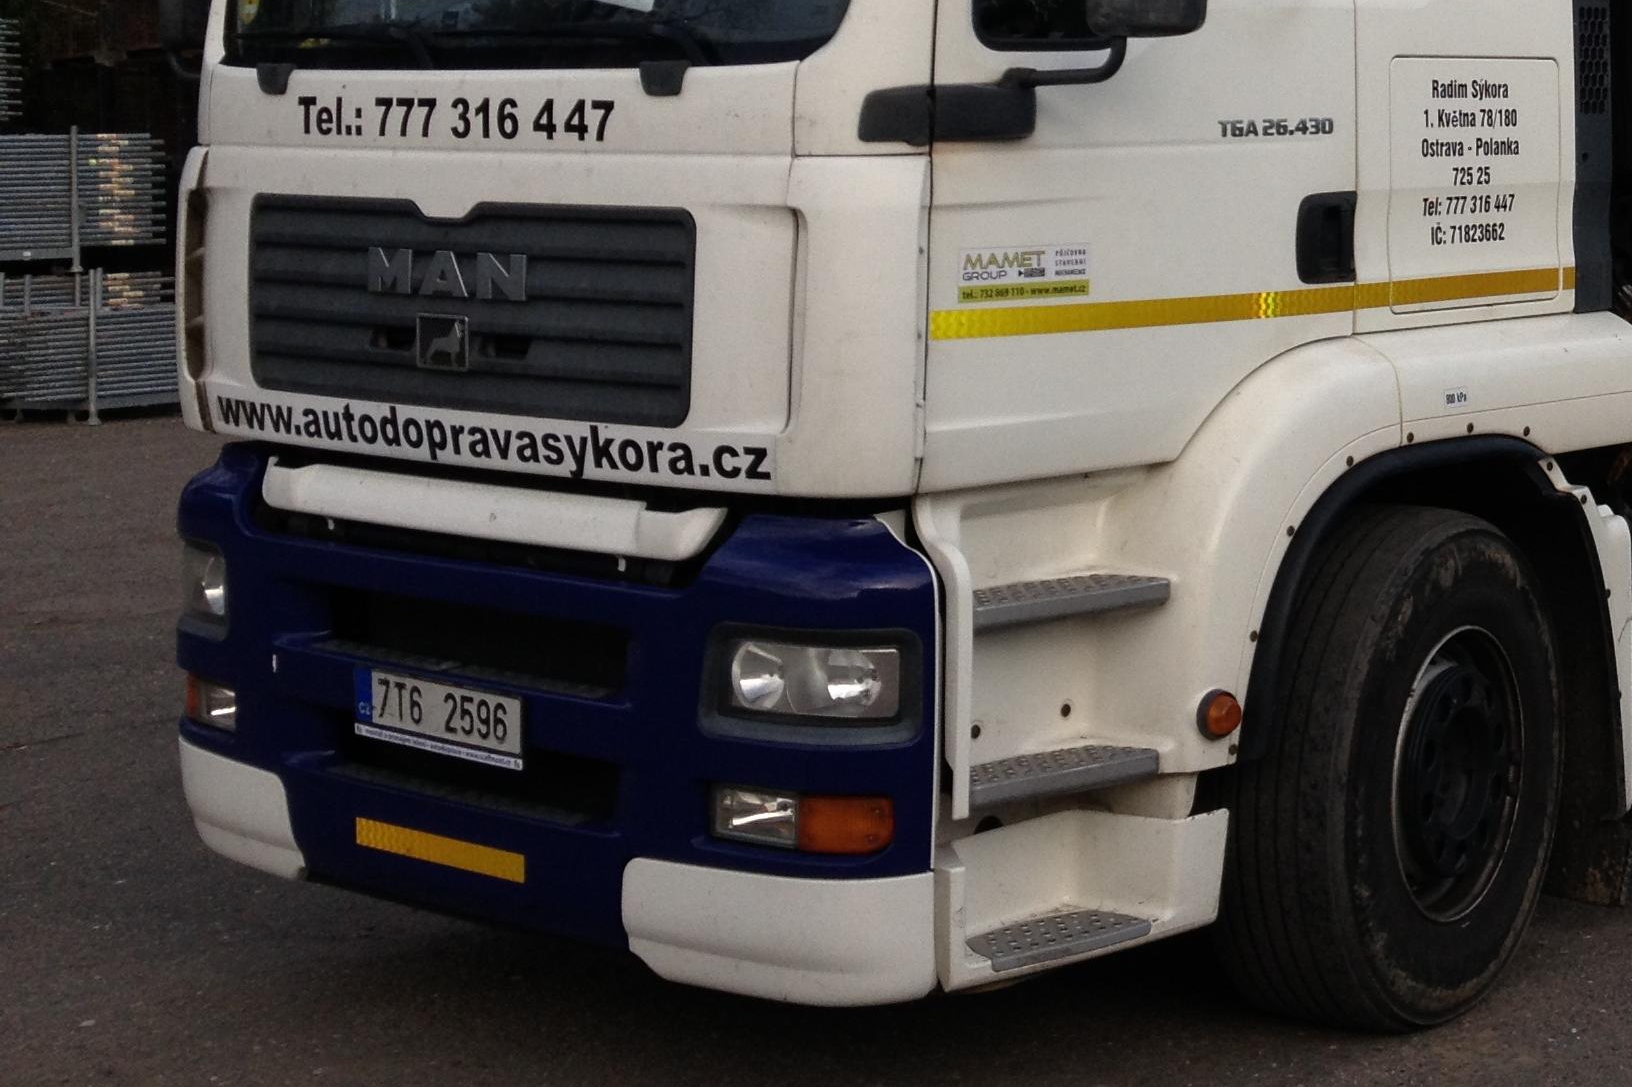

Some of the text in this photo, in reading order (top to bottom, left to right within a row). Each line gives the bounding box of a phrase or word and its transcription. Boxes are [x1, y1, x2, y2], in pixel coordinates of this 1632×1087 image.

[1431, 78, 1509, 101] Radim Sýkora
[298, 96, 363, 137] Tel.:
[374, 97, 437, 138] 777
[450, 97, 519, 140] 316
[1217, 117, 1334, 137] TGA 26.430
[1423, 108, 1518, 129] 1. Května 78/180
[1421, 138, 1464, 157] Ostrava
[1475, 137, 1520, 156] Polanka
[1452, 166, 1491, 186] 725 25
[1422, 193, 1515, 217] Tel: 777 316 447
[1431, 221, 1505, 246] IČ: 71823662
[962, 250, 1046, 271] MAMET
[368, 246, 527, 301] MAN
[962, 269, 1007, 282] GROUP
[216, 394, 772, 480] www.autodopravasykora.cz
[377, 677, 508, 741] 7T6 2596
